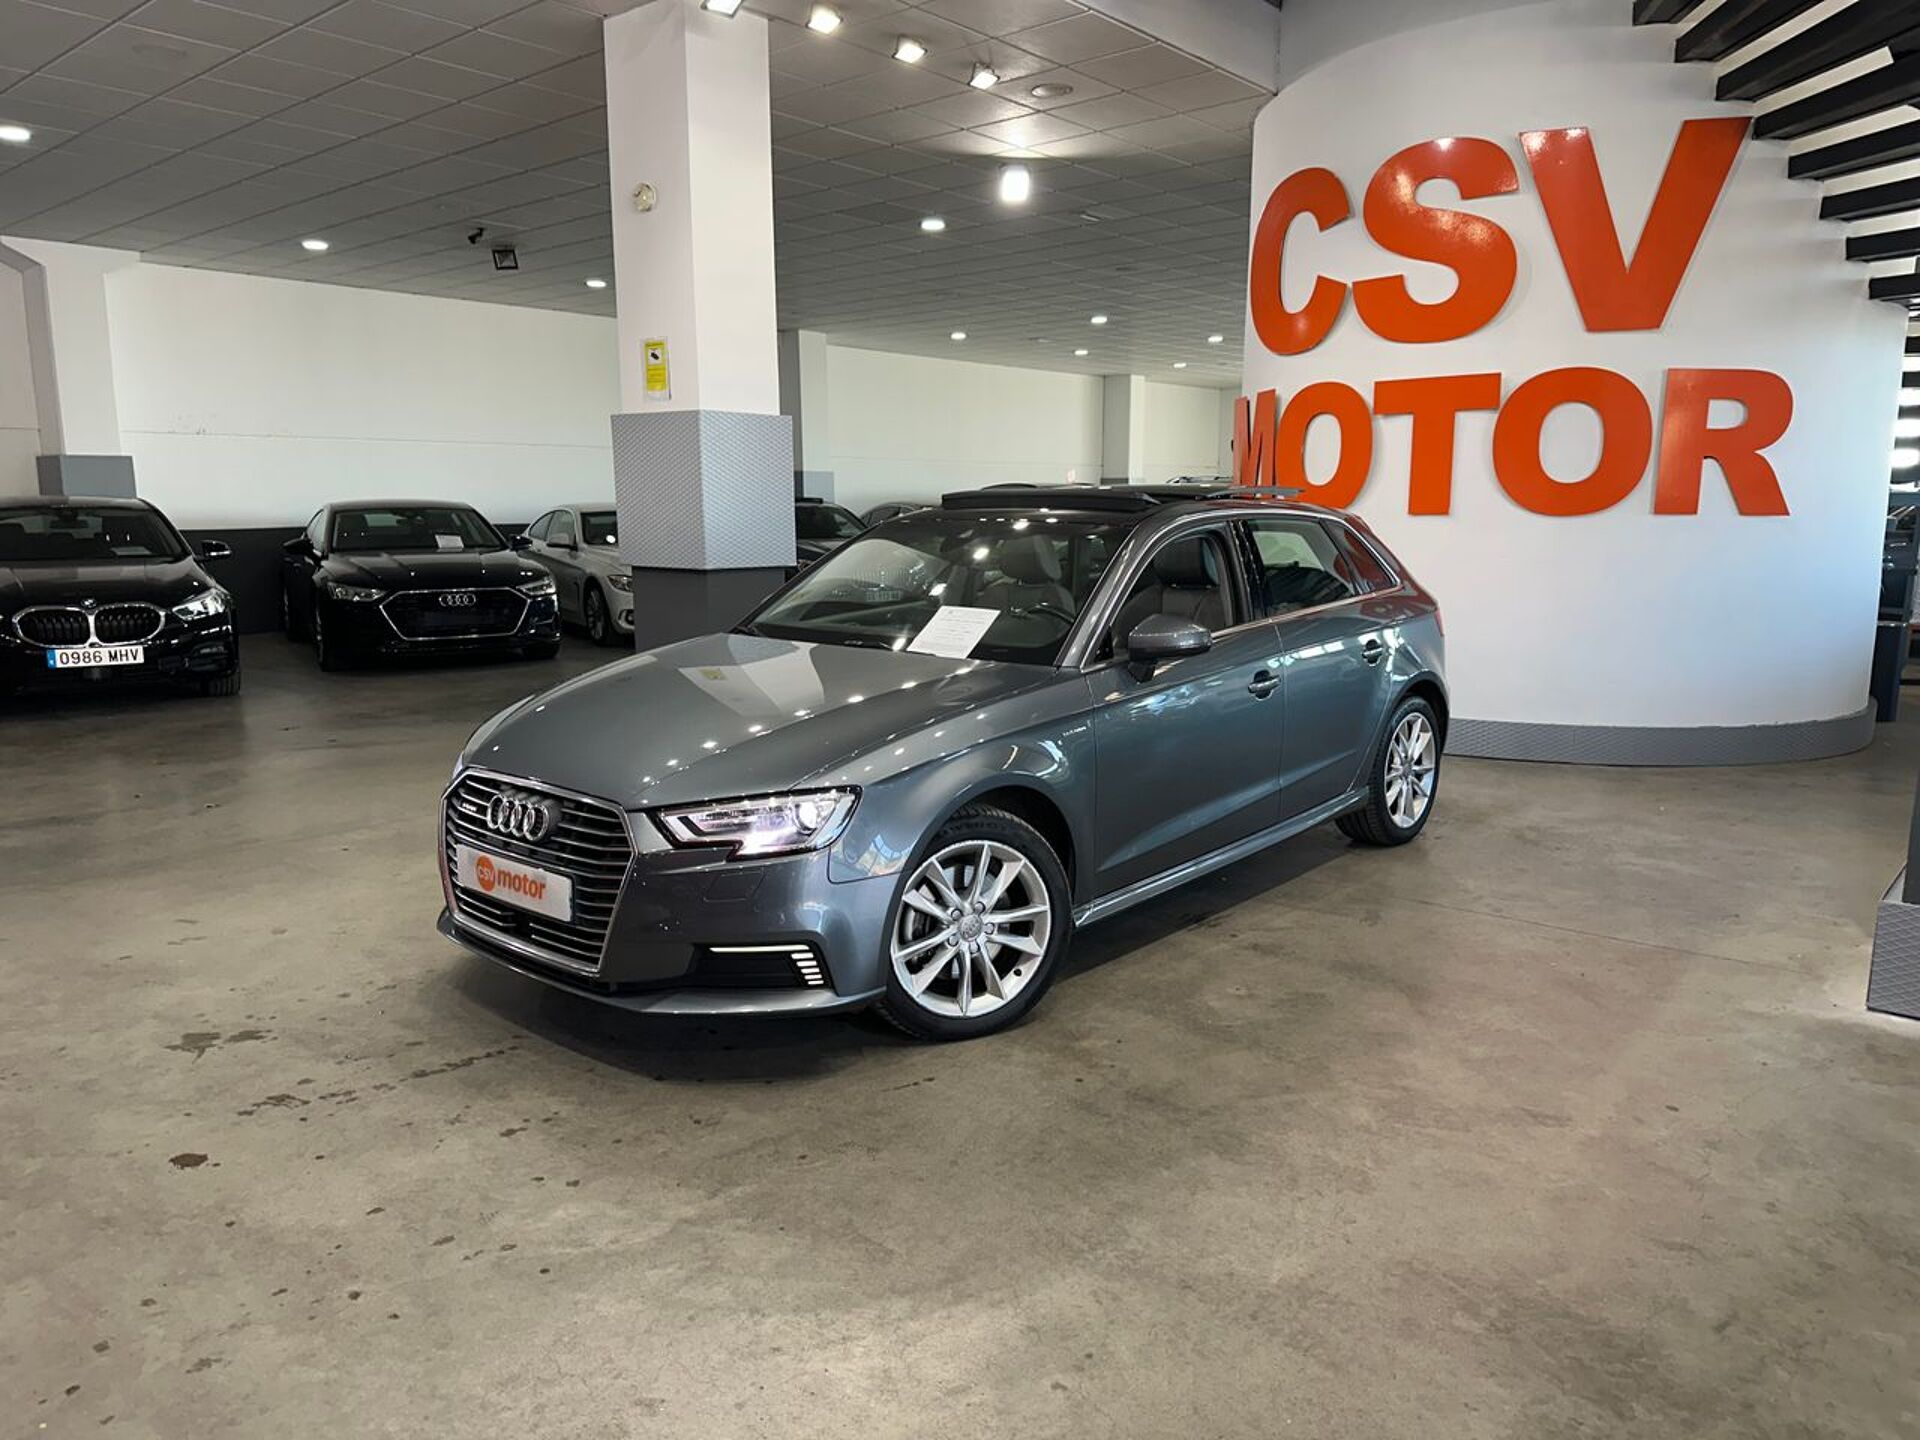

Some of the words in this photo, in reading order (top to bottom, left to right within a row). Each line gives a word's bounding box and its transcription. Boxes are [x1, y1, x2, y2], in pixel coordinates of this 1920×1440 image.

[1250, 117, 1752, 356] CSV
[1233, 367, 1794, 516] MOTOR
[60, 650, 103, 665] 0986
[108, 647, 139, 662] MHV
[497, 868, 546, 900] motor
